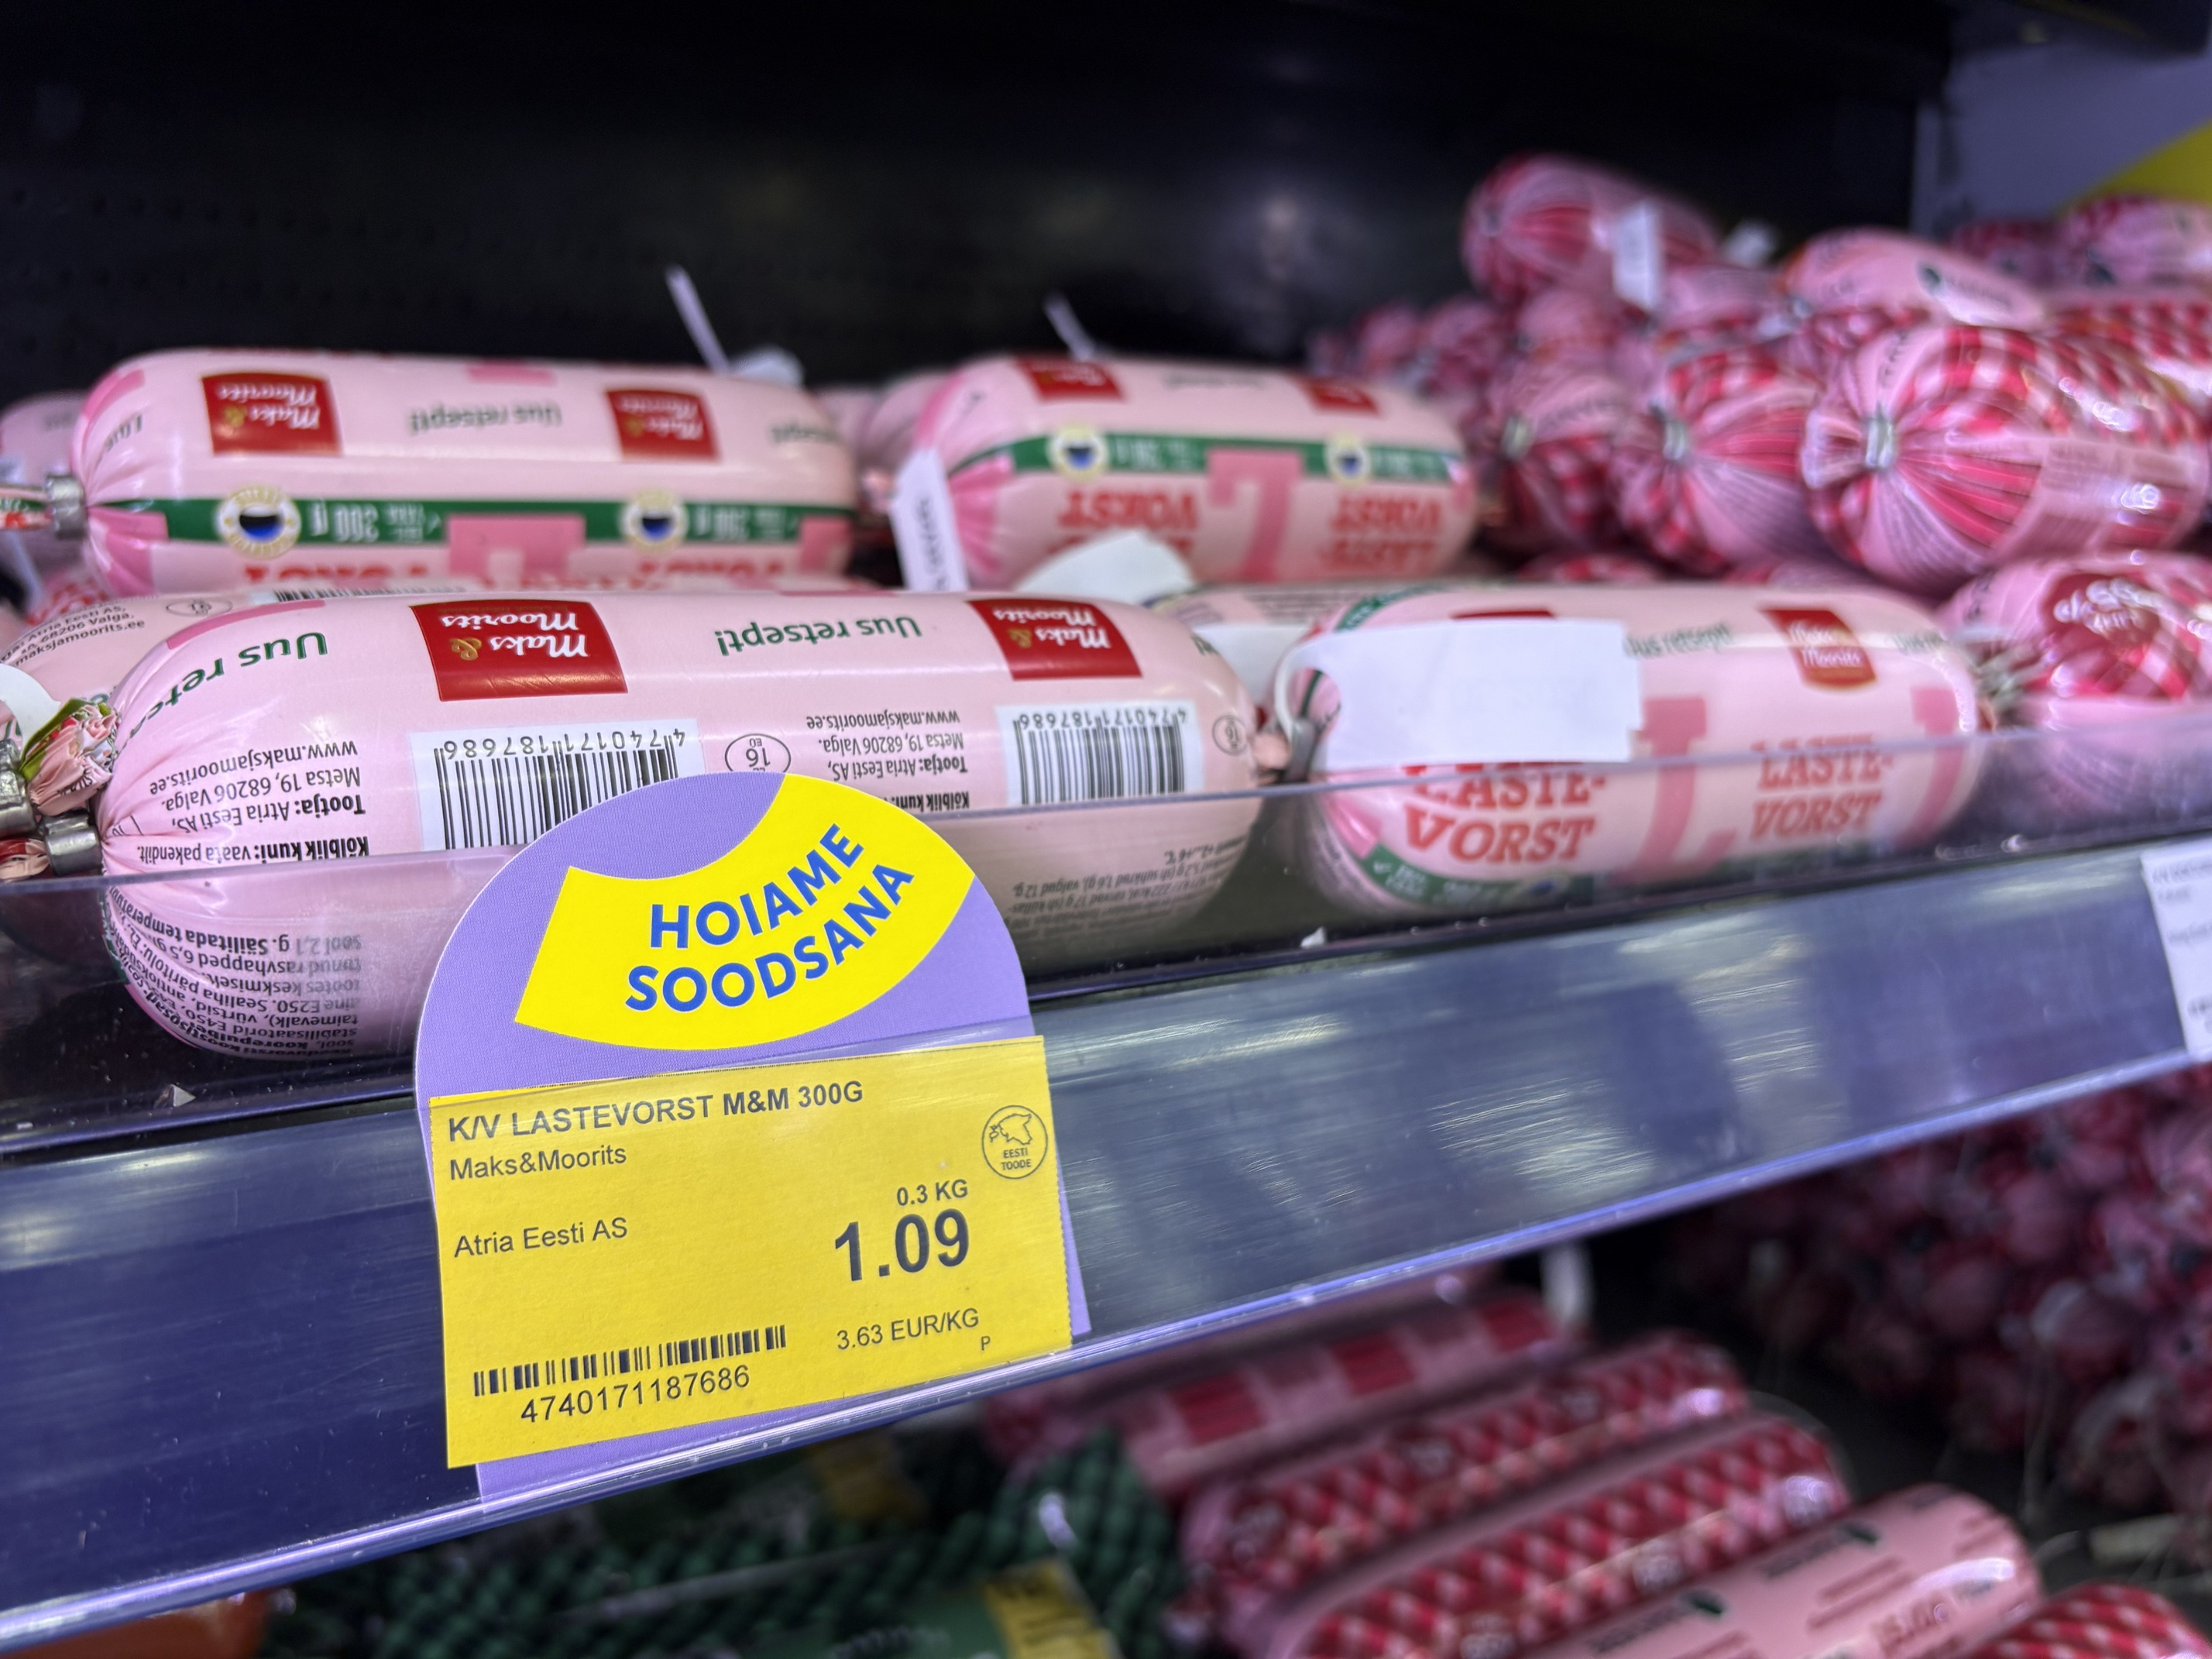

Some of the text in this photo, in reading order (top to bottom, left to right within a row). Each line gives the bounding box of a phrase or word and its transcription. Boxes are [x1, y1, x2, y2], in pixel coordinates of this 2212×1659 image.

[442, 613, 579, 631] Moorits
[238, 631, 328, 667] Uus
[489, 634, 589, 658] Maks
[715, 617, 923, 657] Uus retsept!
[1035, 627, 1111, 650] Maks
[806, 709, 960, 730] www.maksjamoorits.ee
[818, 732, 964, 757] Metsa 19, 68206 Valga.
[149, 740, 358, 795] www.maksjamoorits.ee
[745, 747, 771, 768] 16
[887, 758, 917, 775] Atria
[919, 756, 968, 775] Tootja:
[853, 761, 884, 780] Eesti
[161, 767, 362, 812] Metsa 19, 68206 Valga.
[247, 801, 290, 821] Atria
[294, 794, 366, 818] Tootja:
[928, 792, 970, 812] Kõlblik
[201, 806, 243, 829] Eesti
[1403, 803, 1596, 863] VORST
[255, 841, 302, 861] kuni:
[304, 836, 370, 860] Kõlblik
[650, 823, 864, 949] HOIAME
[185, 929, 269, 956] Säilitada
[271, 933, 290, 953] g.
[625, 864, 915, 1012] SOODSANA
[169, 946, 194, 963] 6,5
[198, 953, 304, 977] rasvhapped
[191, 997, 257, 1024] vürtsid,
[203, 988, 268, 1012] Sealiha
[273, 1000, 321, 1014] E250.
[264, 1014, 359, 1029] taimevalk),
[448, 1080, 864, 1142] K/V LASTEVORST M&M 300G
[450, 1145, 627, 1181] Maks&Moorits
[1001, 1159, 1032, 1171] TOODE
[1002, 1148, 1029, 1159] EESTI
[896, 1178, 969, 1207] 0.3 KG
[454, 1217, 628, 1259] Atria Eesti AS
[834, 1207, 970, 1282] 1.09
[836, 1307, 980, 1350] 3.63 EUR/KG
[980, 1336, 991, 1351] P
[520, 1365, 750, 1424] 4740171187686
